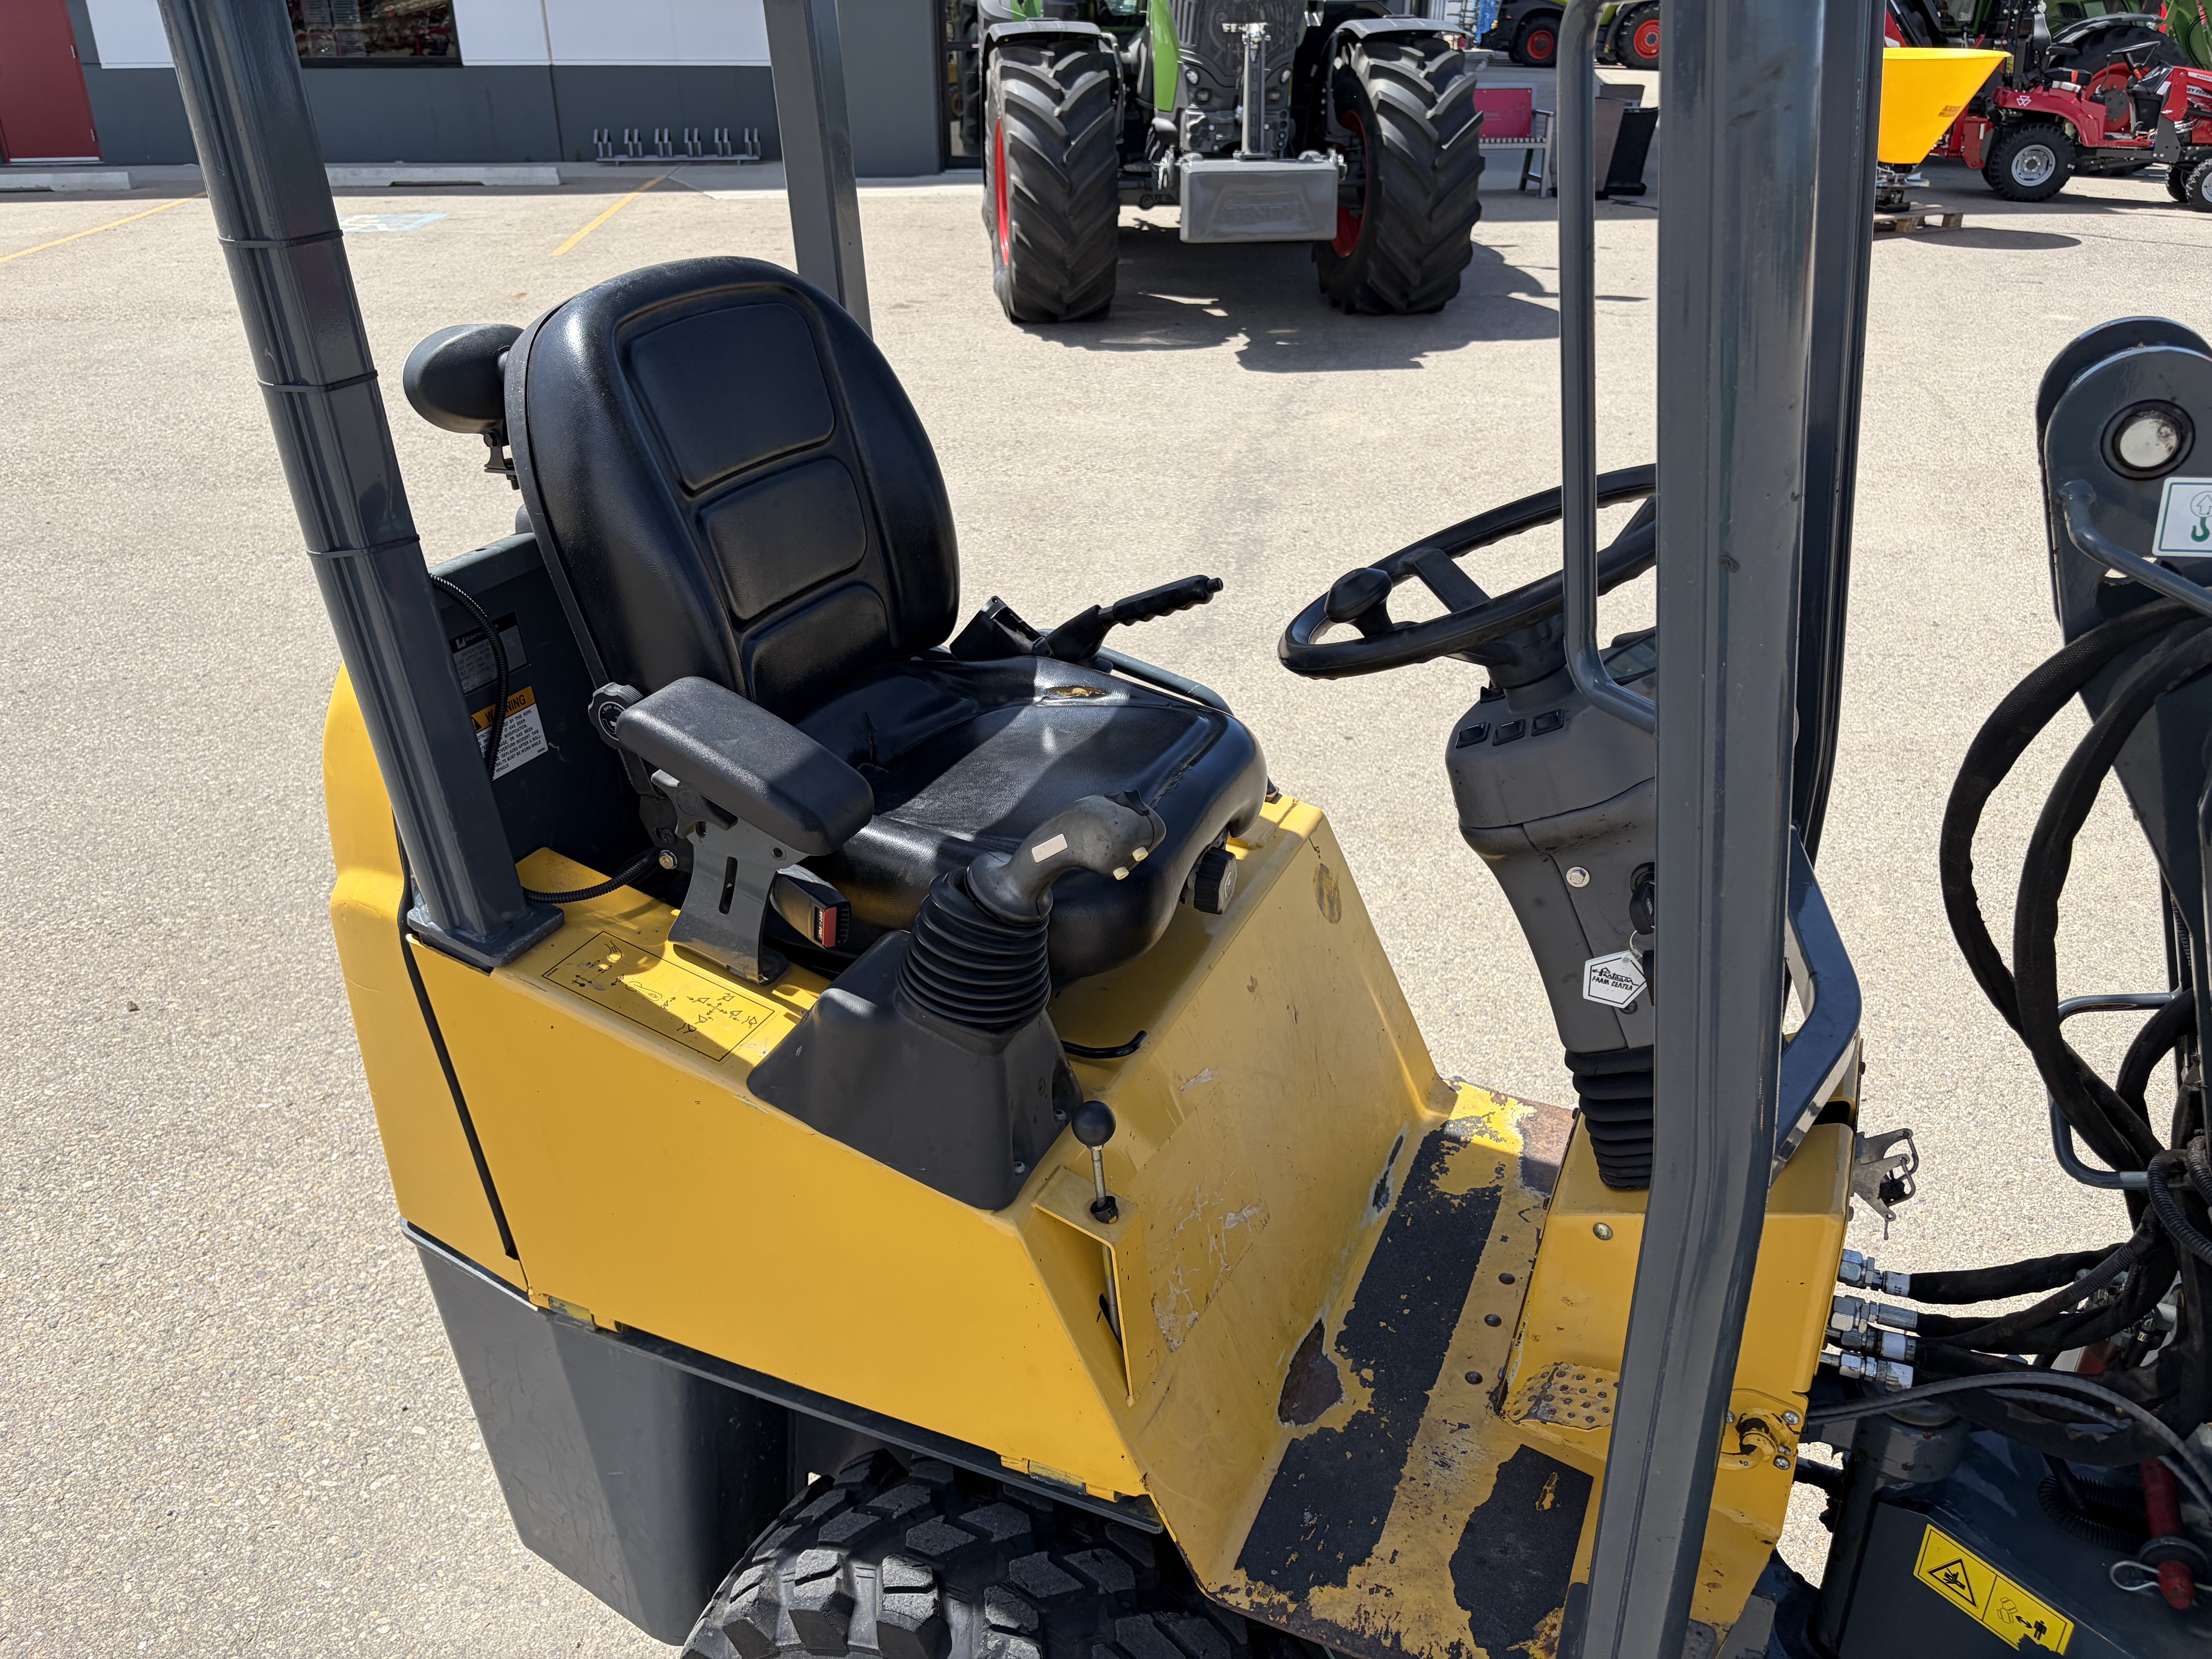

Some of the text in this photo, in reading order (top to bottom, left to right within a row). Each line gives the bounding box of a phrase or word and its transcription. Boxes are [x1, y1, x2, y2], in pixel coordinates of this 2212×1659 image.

[485, 694, 526, 722] WNING
[519, 740, 529, 749] AFTER
[507, 753, 515, 761] MUST
